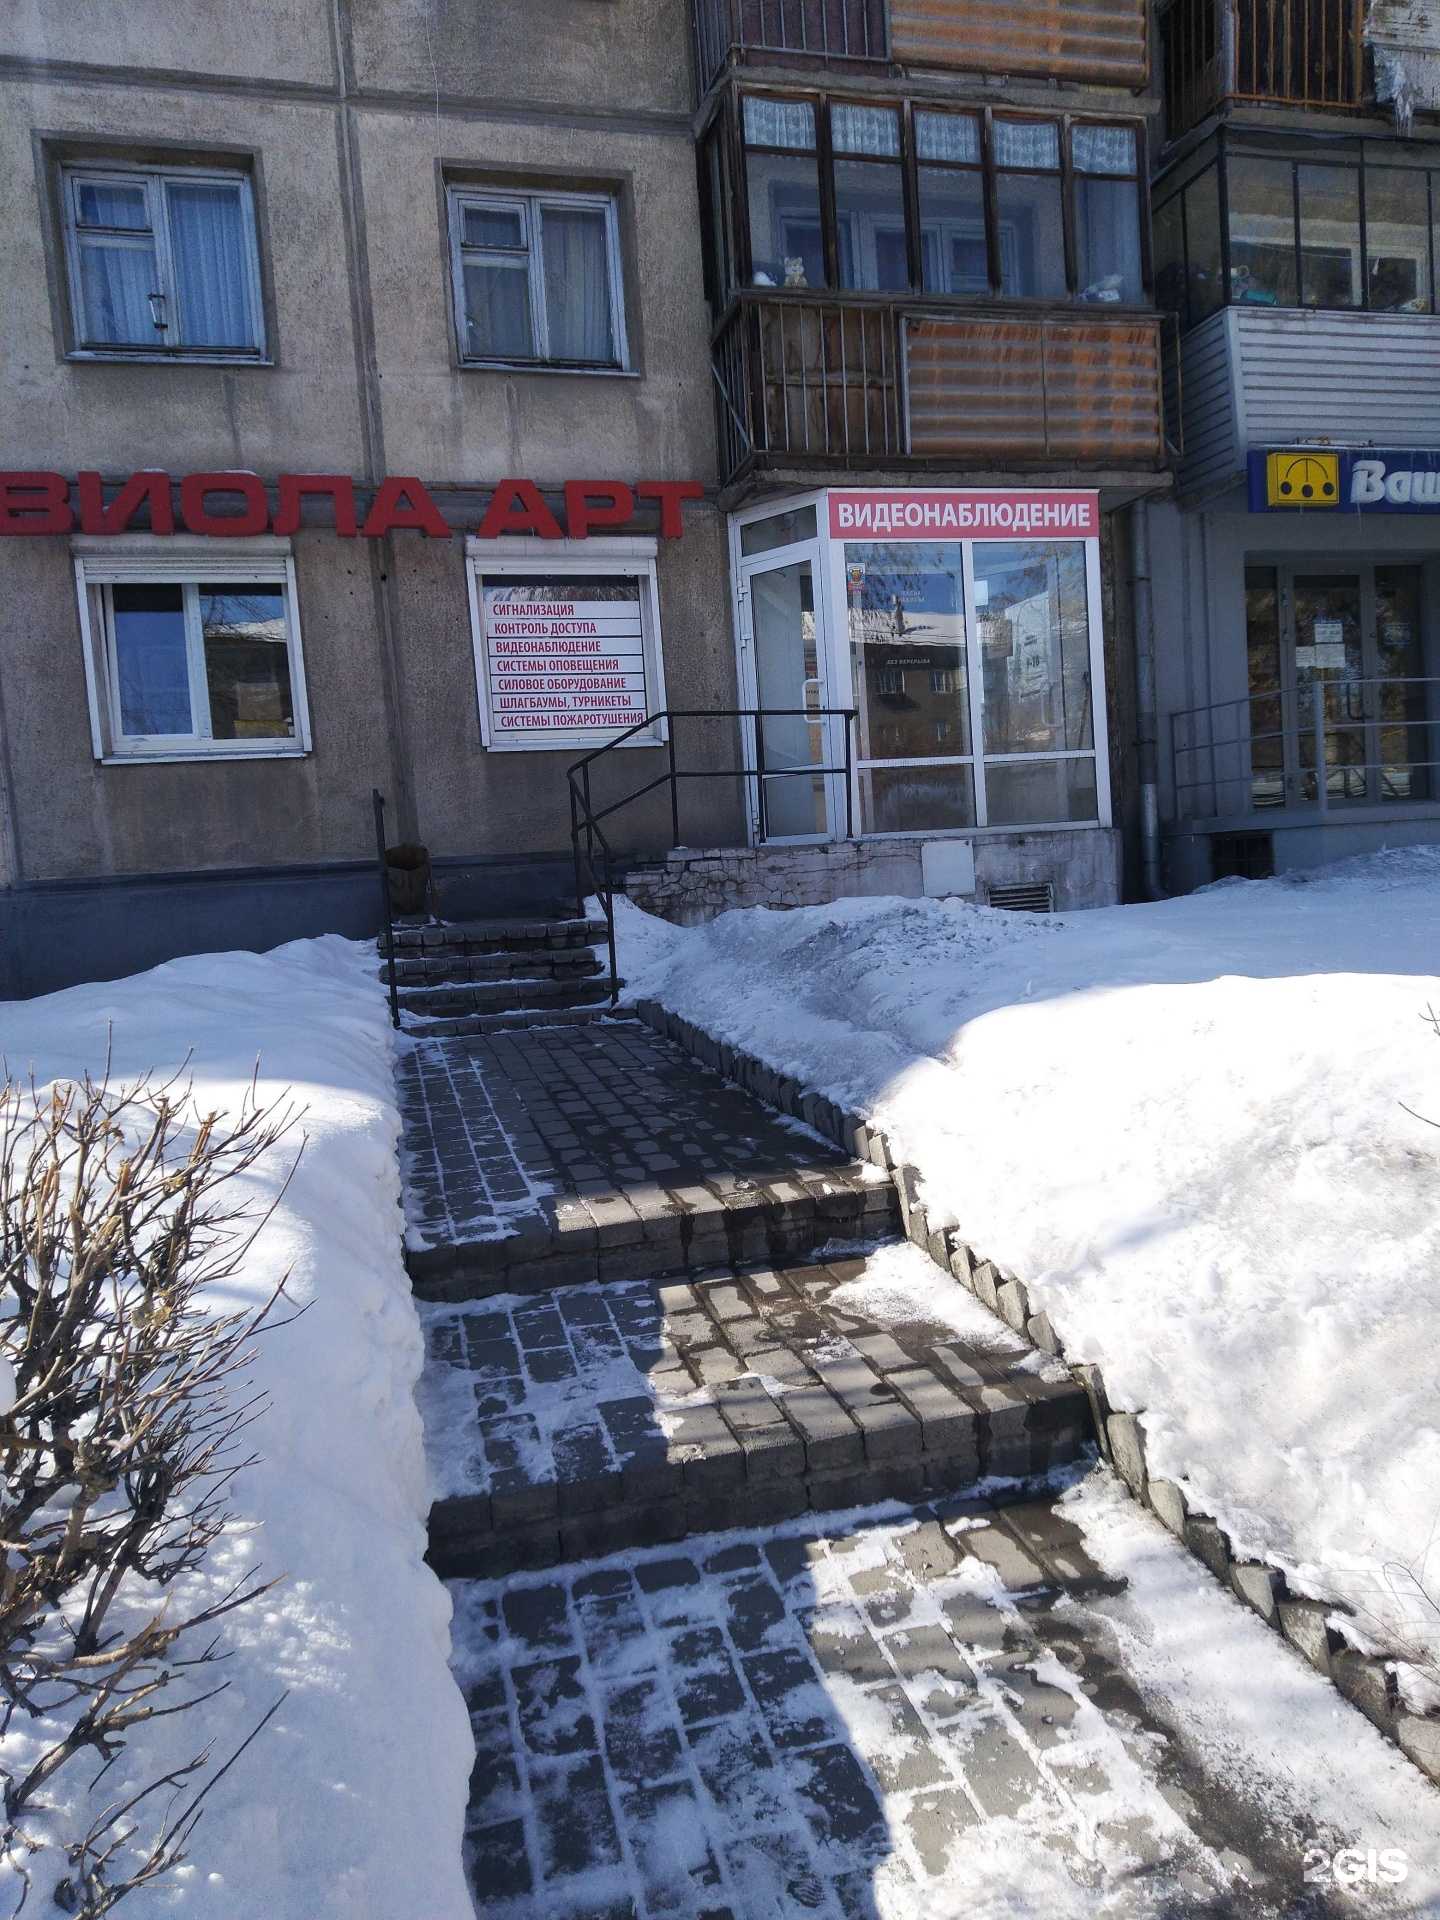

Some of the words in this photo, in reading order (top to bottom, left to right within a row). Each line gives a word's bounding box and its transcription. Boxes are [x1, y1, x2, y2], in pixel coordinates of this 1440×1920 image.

[0, 470, 451, 538] ВИОЛА
[478, 478, 704, 539] АРТ
[838, 502, 1091, 532] ВИДЕОНАБЛЮДЕНИЕ
[493, 604, 574, 617] СИГНАЛИЗАЦИЯ
[494, 622, 548, 634] КОНТРОЛЬ
[550, 622, 597, 635] ДОСТУПА
[496, 641, 601, 654] ВИДЕОНАБЛЮДЕНИЕ
[497, 660, 547, 672] СИСТЕМЫ
[549, 659, 619, 672] ОПОВЕЩЕНИЯ
[498, 678, 545, 690] СИЛОВОЕ
[547, 677, 626, 692] ОБОРУДОВАНИЕ
[500, 697, 570, 709] ШЛАГБАУМЫ,
[572, 696, 632, 707] ТУРНИКЕТЫ
[501, 715, 550, 727] СИСТЕМЫ
[552, 713, 644, 727] ПОЖАРОТУШЕНИЯ
